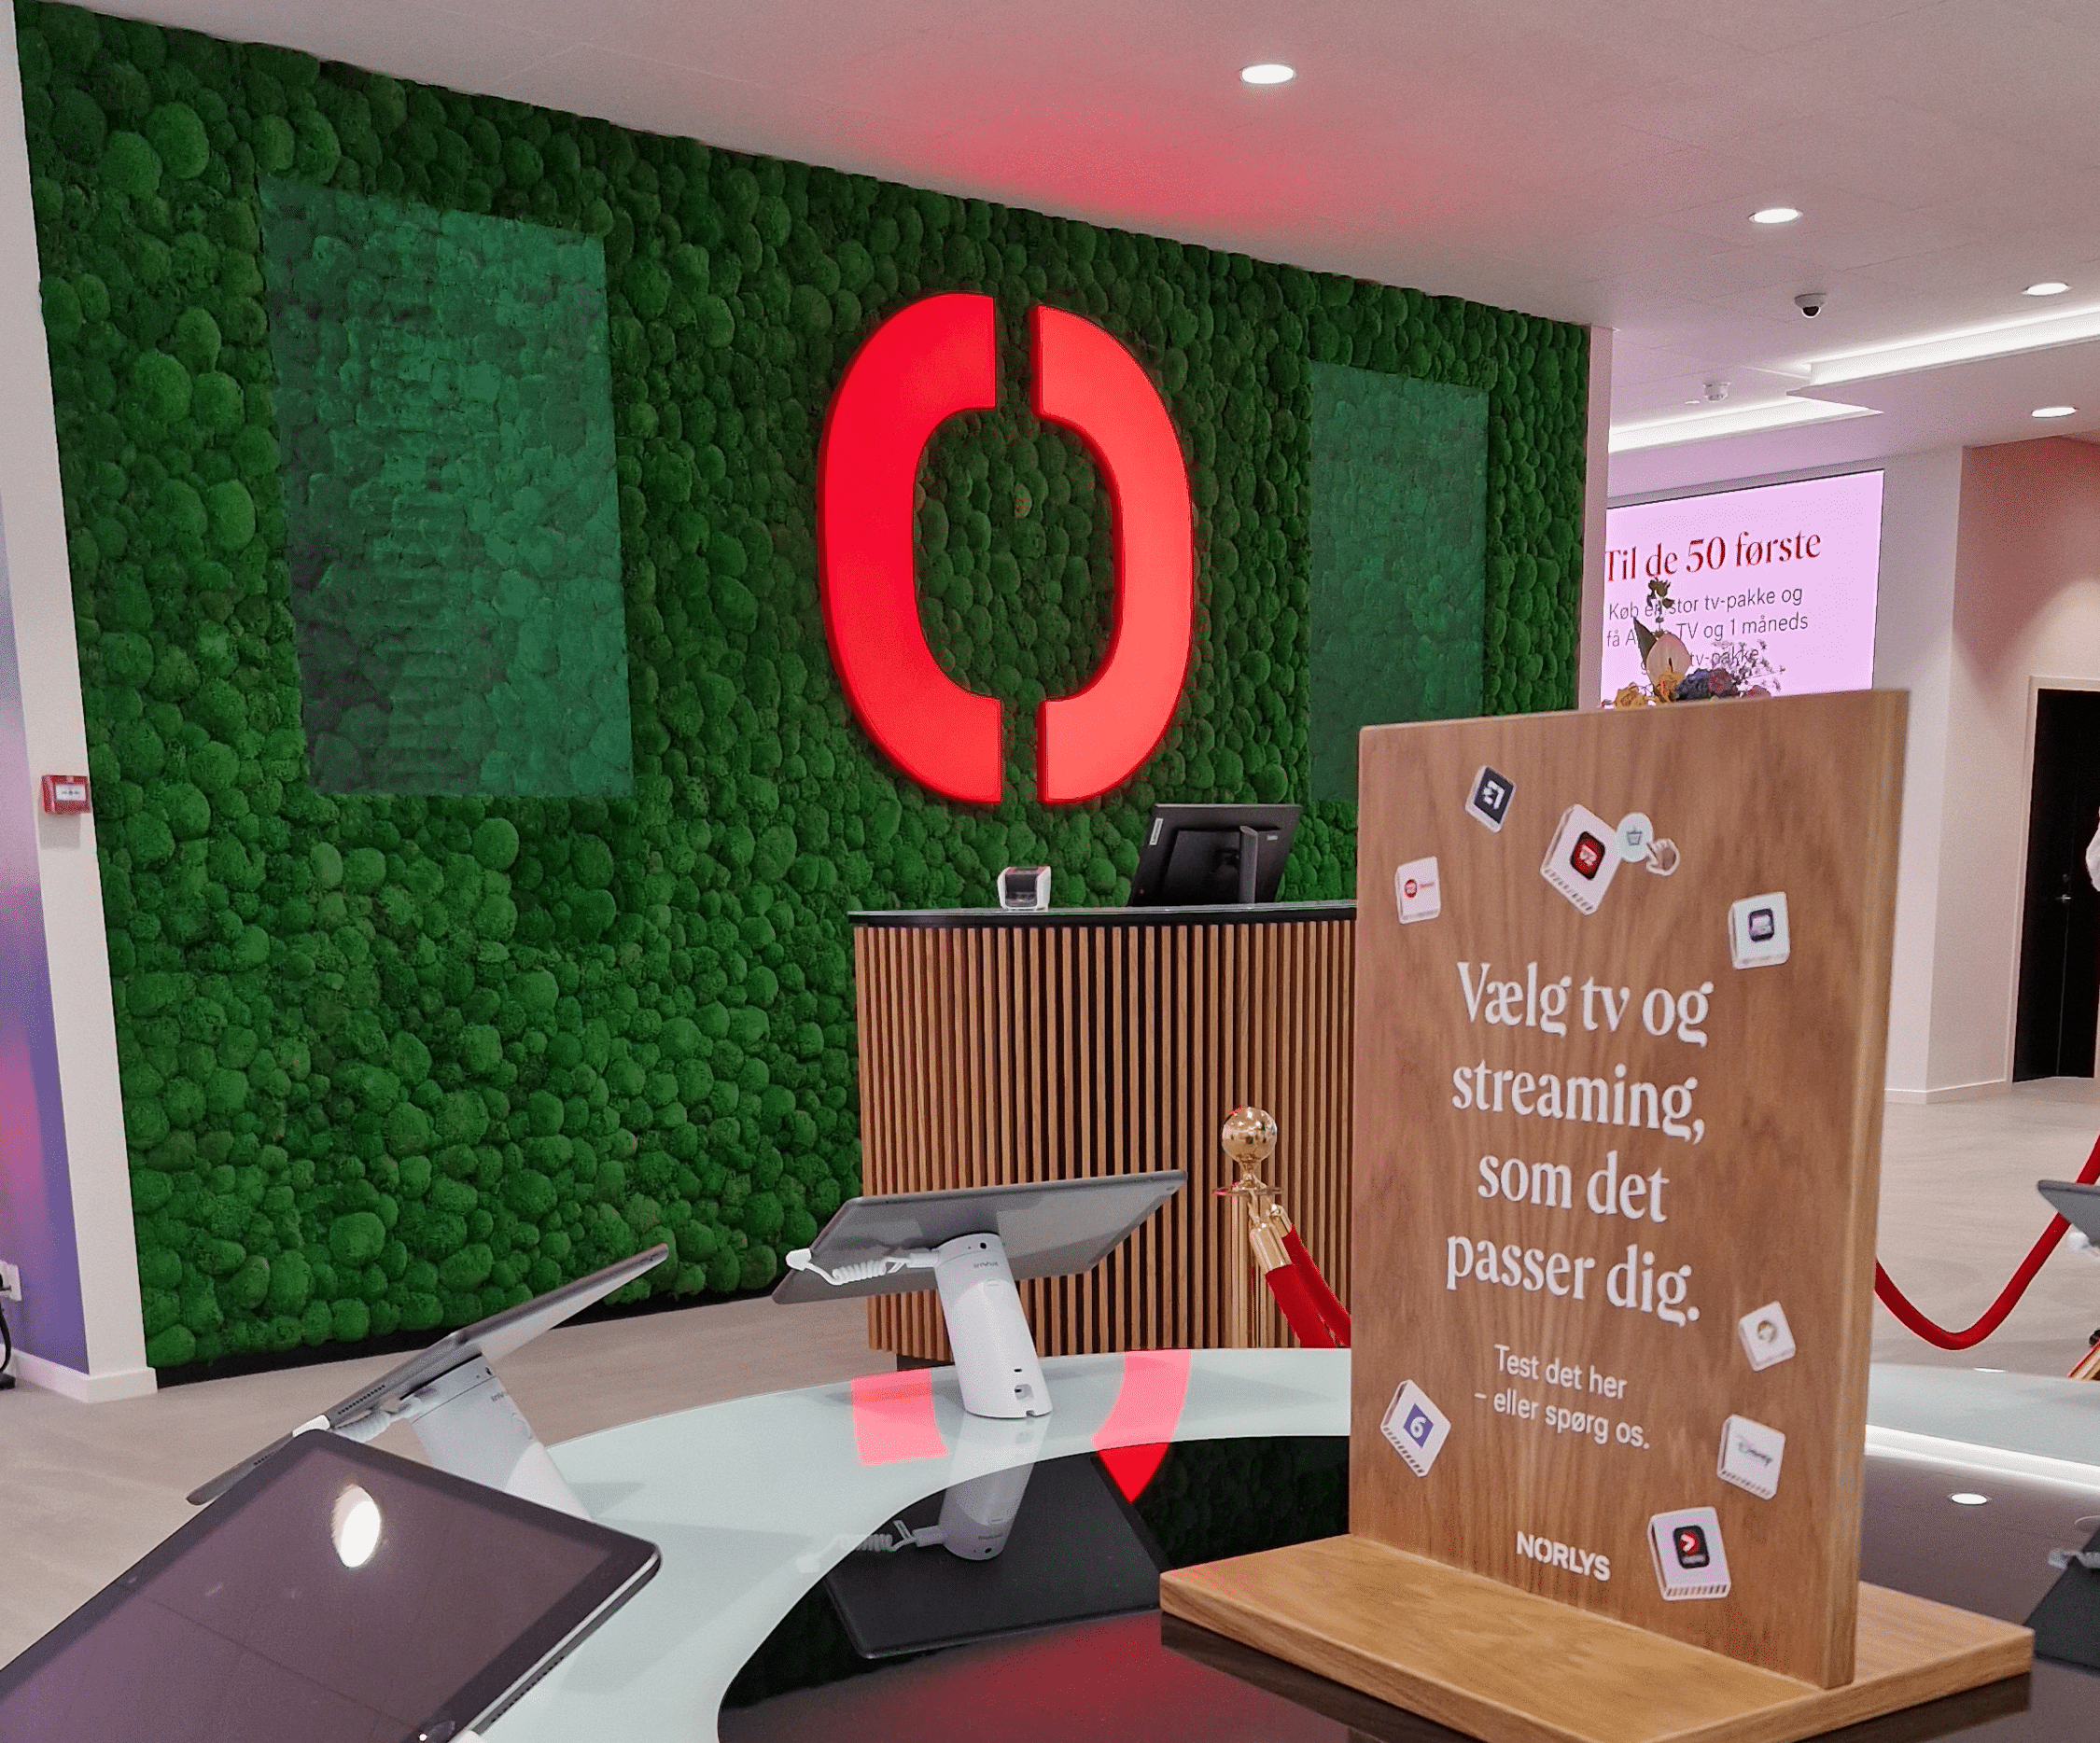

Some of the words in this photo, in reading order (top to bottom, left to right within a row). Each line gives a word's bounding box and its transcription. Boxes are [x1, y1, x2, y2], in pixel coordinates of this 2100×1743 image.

[1604, 546, 1636, 582] Til
[1645, 543, 1678, 578] de
[1686, 536, 1726, 573] 50
[1735, 530, 1822, 567] første
[1606, 629, 1620, 647] få
[1676, 621, 1699, 640] TV
[1703, 623, 1724, 641] og
[1730, 618, 1736, 635] 1
[1742, 612, 1809, 634] måneds
[1609, 602, 1639, 621] Køb
[1669, 599, 1699, 614] stor
[1704, 587, 1775, 612] tv-pakke
[1781, 588, 1803, 606] og
[1457, 960, 1572, 1036] Vælg
[1580, 976, 1630, 1032] tv
[1642, 981, 1715, 1048] og
[1451, 1058, 1706, 1146] streaming,
[1477, 1155, 1573, 1209] som
[1586, 1150, 1670, 1223] det
[1446, 1234, 1596, 1300] passer
[1606, 1244, 1701, 1327] dig.
[1494, 1344, 1540, 1381] Test
[1545, 1360, 1583, 1390] det
[1589, 1365, 1628, 1400] her
[1410, 1415, 1427, 1440] 6
[1493, 1387, 1539, 1421] eller
[1545, 1404, 1609, 1443] spørg
[1616, 1420, 1651, 1450] os.
[1516, 1530, 1611, 1583] NORLYS
